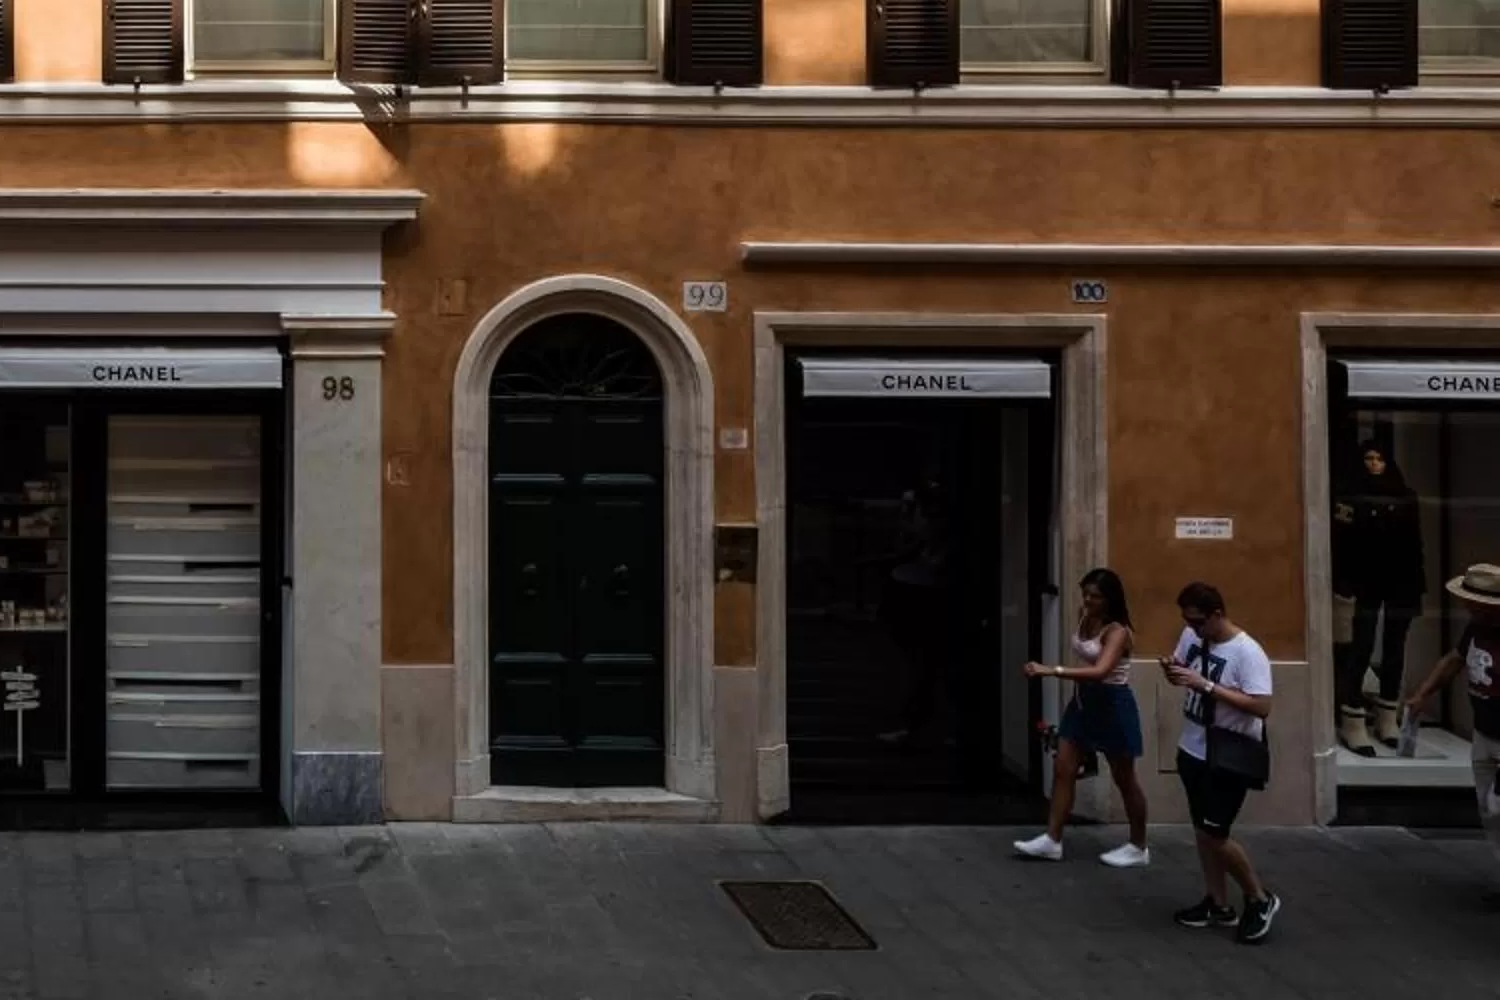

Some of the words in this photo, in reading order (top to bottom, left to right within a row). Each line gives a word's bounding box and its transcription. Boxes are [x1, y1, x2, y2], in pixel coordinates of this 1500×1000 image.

[689, 284, 724, 307] 99
[1075, 283, 1105, 300] 100
[92, 366, 181, 381] CHANEL
[322, 376, 354, 400] 98
[882, 375, 972, 391] CHANEL
